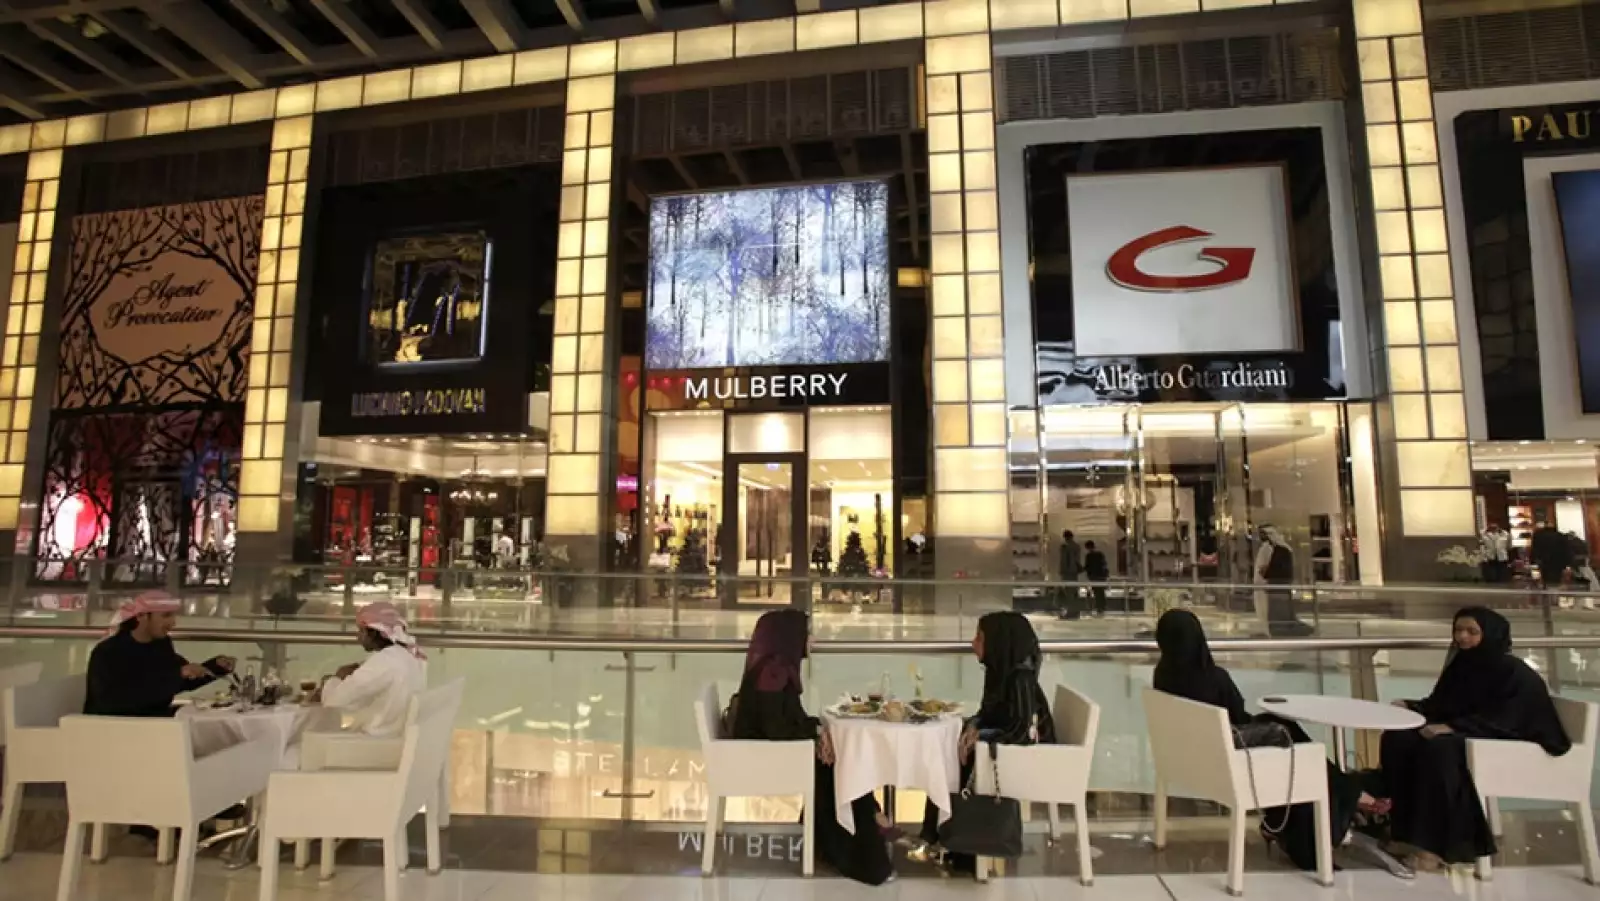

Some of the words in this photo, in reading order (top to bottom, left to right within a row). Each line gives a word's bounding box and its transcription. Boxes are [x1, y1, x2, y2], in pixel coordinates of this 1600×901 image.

[1510, 110, 1600, 143] PAU
[1104, 225, 1256, 293] G
[132, 272, 214, 309] Agent
[103, 300, 224, 330] Provocateur
[684, 372, 848, 399] MULBERRY
[1094, 364, 1174, 391] Alberto
[1177, 360, 1288, 389] Guardiani
